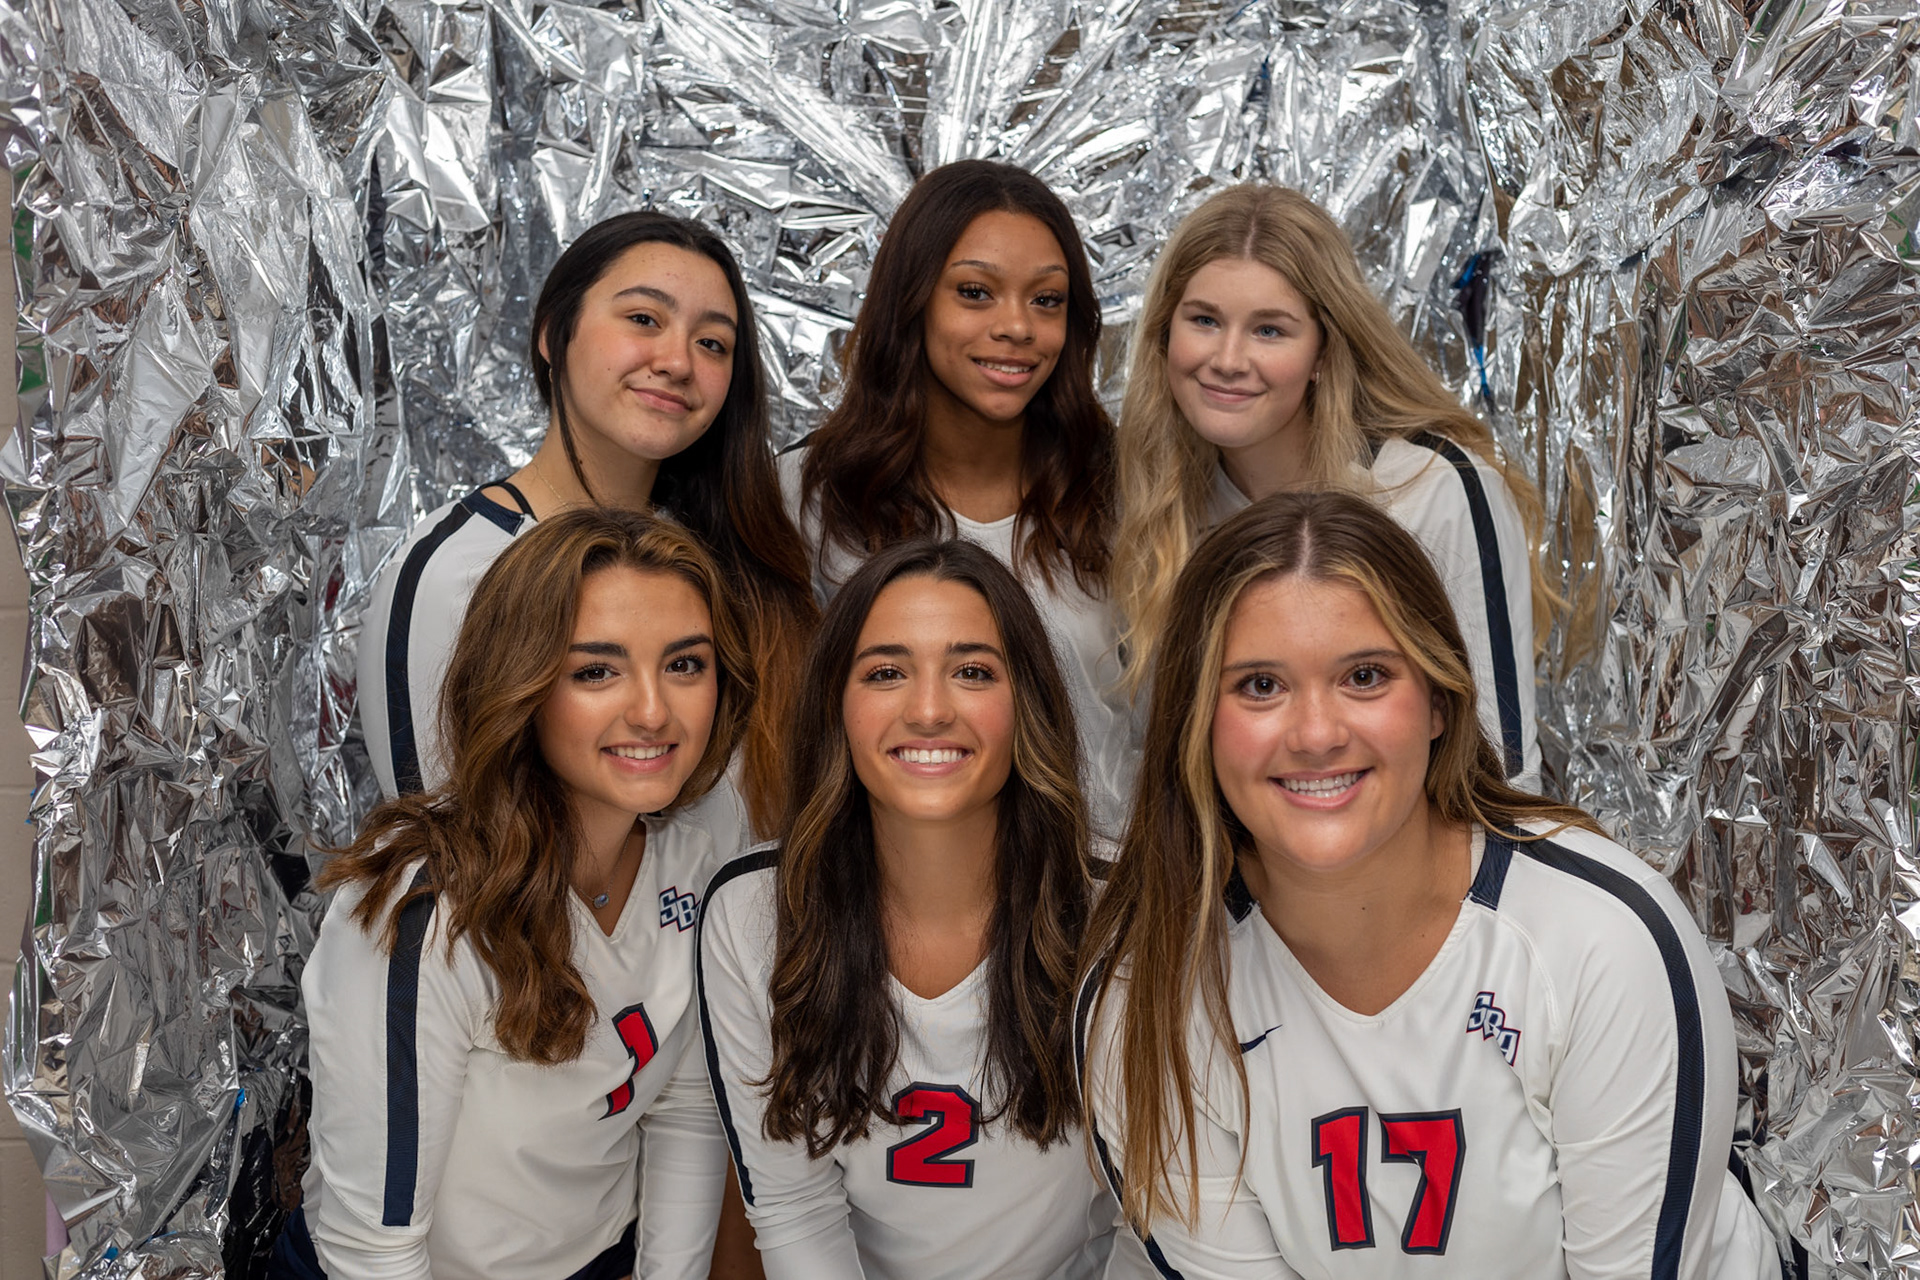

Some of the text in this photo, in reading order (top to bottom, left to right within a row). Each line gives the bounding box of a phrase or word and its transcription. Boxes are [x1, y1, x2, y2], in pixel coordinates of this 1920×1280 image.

[659, 886, 701, 933] SB
[886, 1081, 980, 1188] 2
[1311, 1106, 1467, 1255] 17
